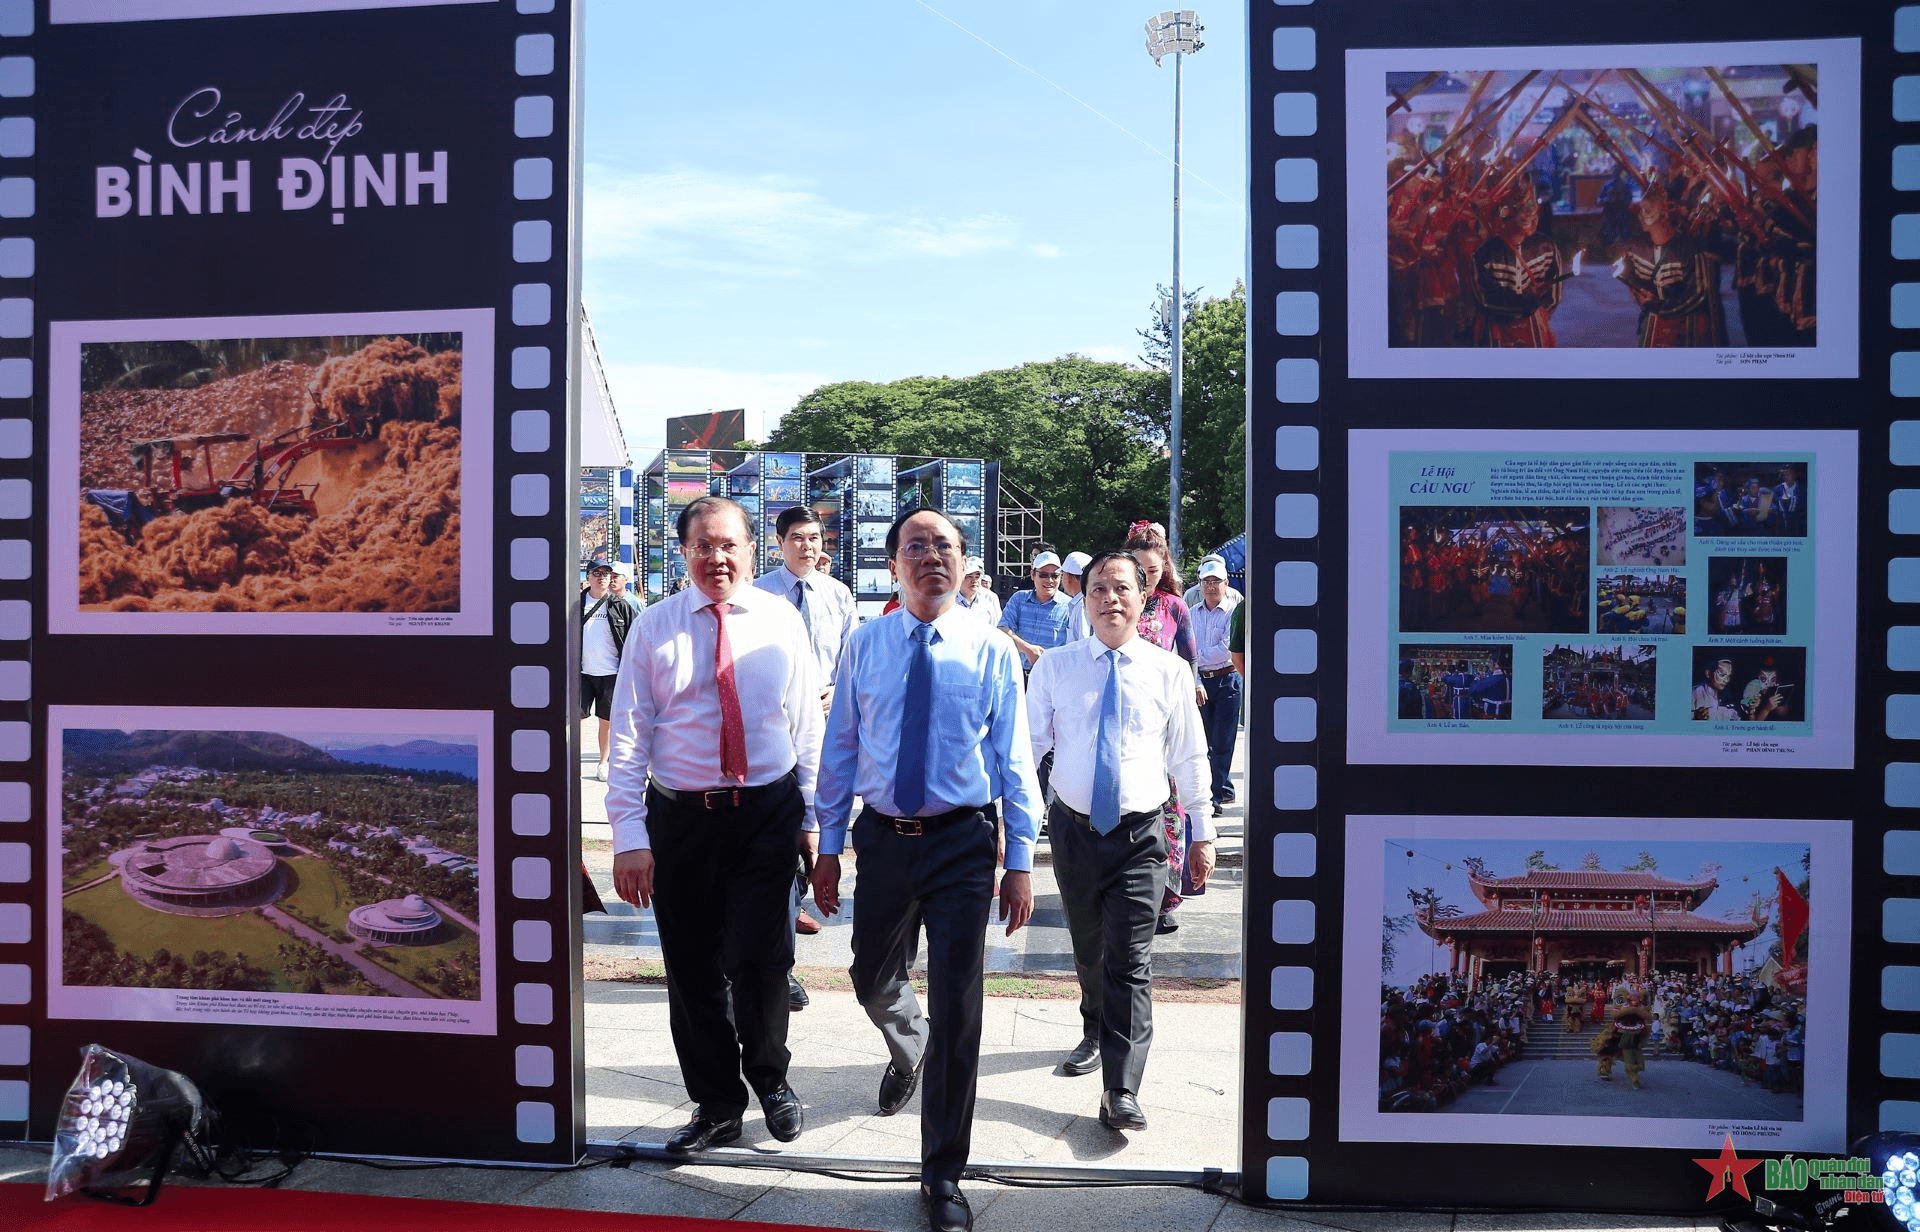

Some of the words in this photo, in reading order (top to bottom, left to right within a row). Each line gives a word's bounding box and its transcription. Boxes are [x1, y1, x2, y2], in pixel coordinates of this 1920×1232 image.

[167, 87, 302, 148] Cảnh
[298, 94, 363, 164] đẹp
[95, 148, 251, 218] BÌNH
[278, 151, 448, 225] ĐỊNH
[1436, 468, 1455, 479] Hội
